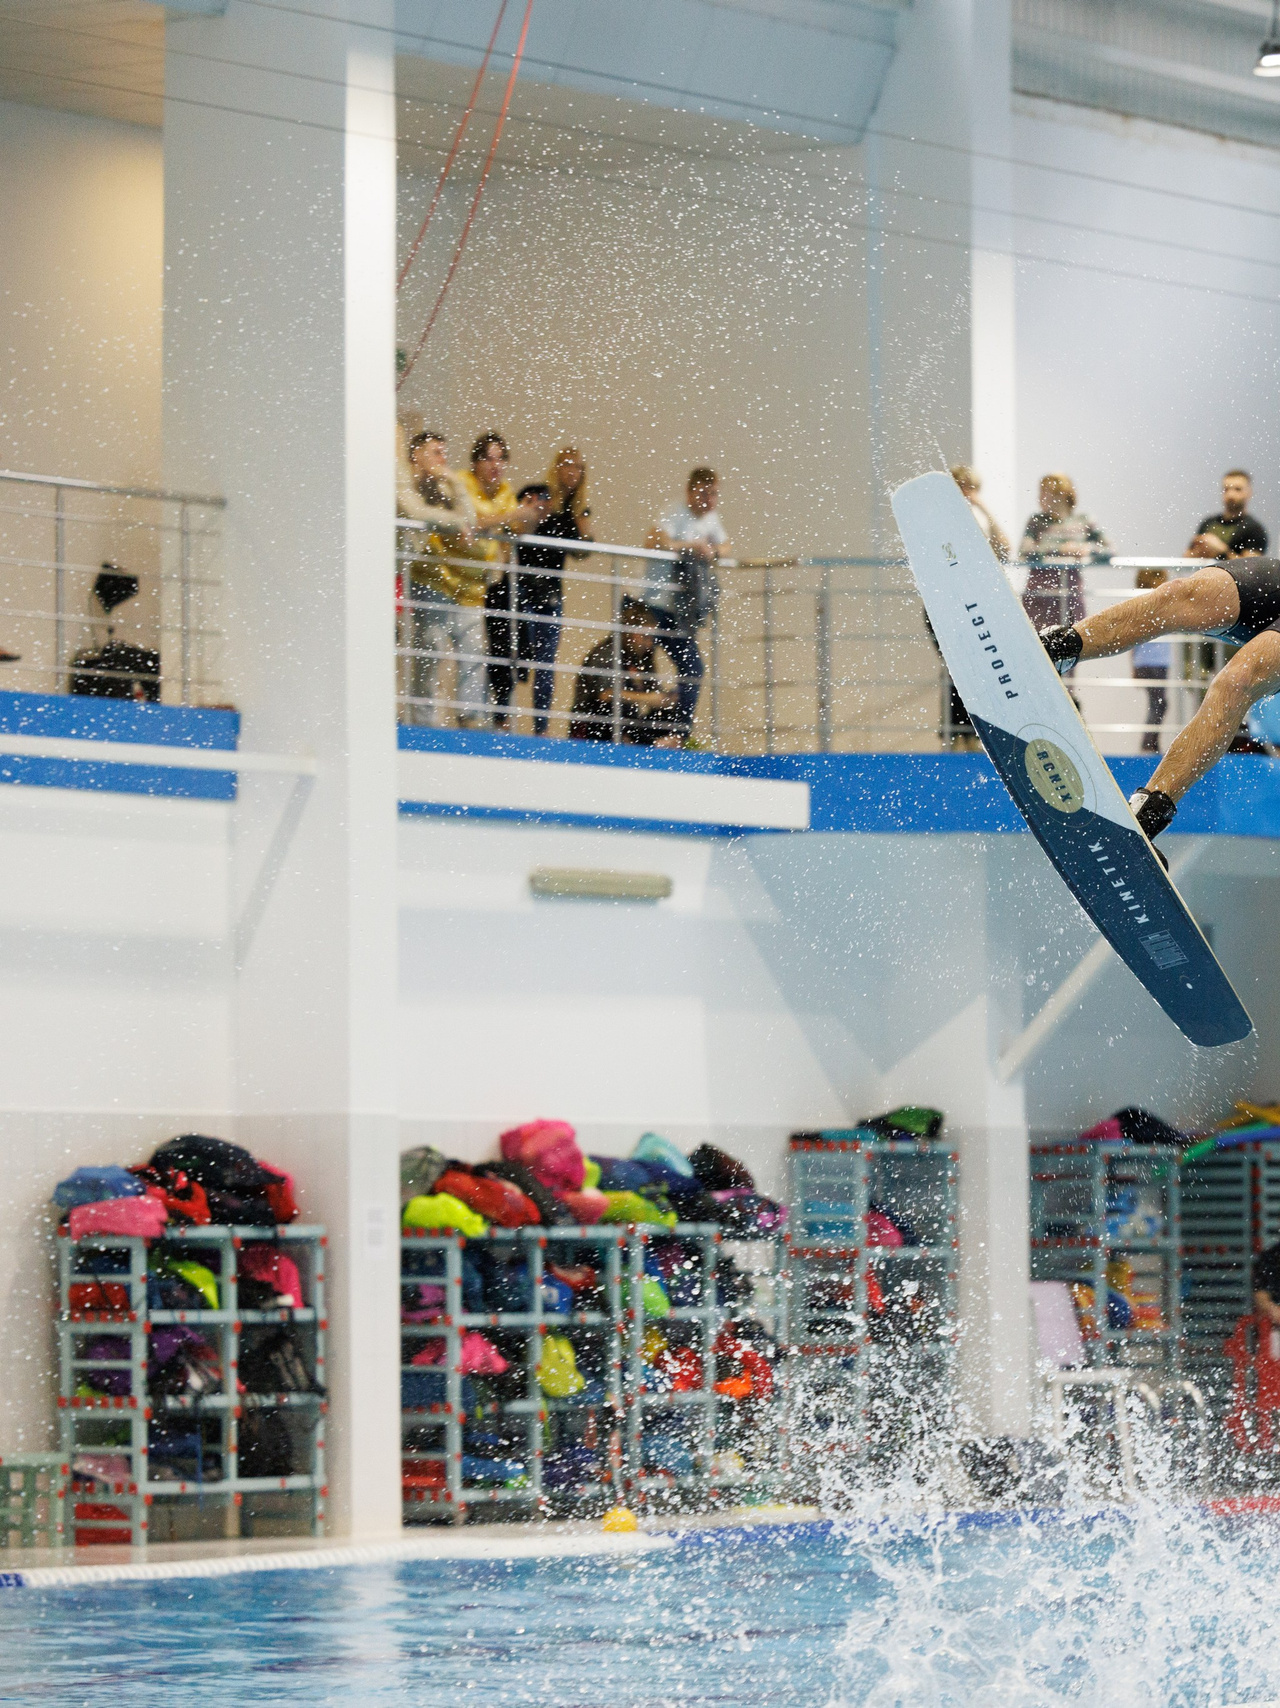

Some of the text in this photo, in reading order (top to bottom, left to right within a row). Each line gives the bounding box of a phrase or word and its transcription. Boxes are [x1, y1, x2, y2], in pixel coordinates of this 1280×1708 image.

[964, 602, 1019, 700] PROJECT
[1036, 750, 1073, 803] RONIX
[1088, 842, 1149, 925] KINETIK
